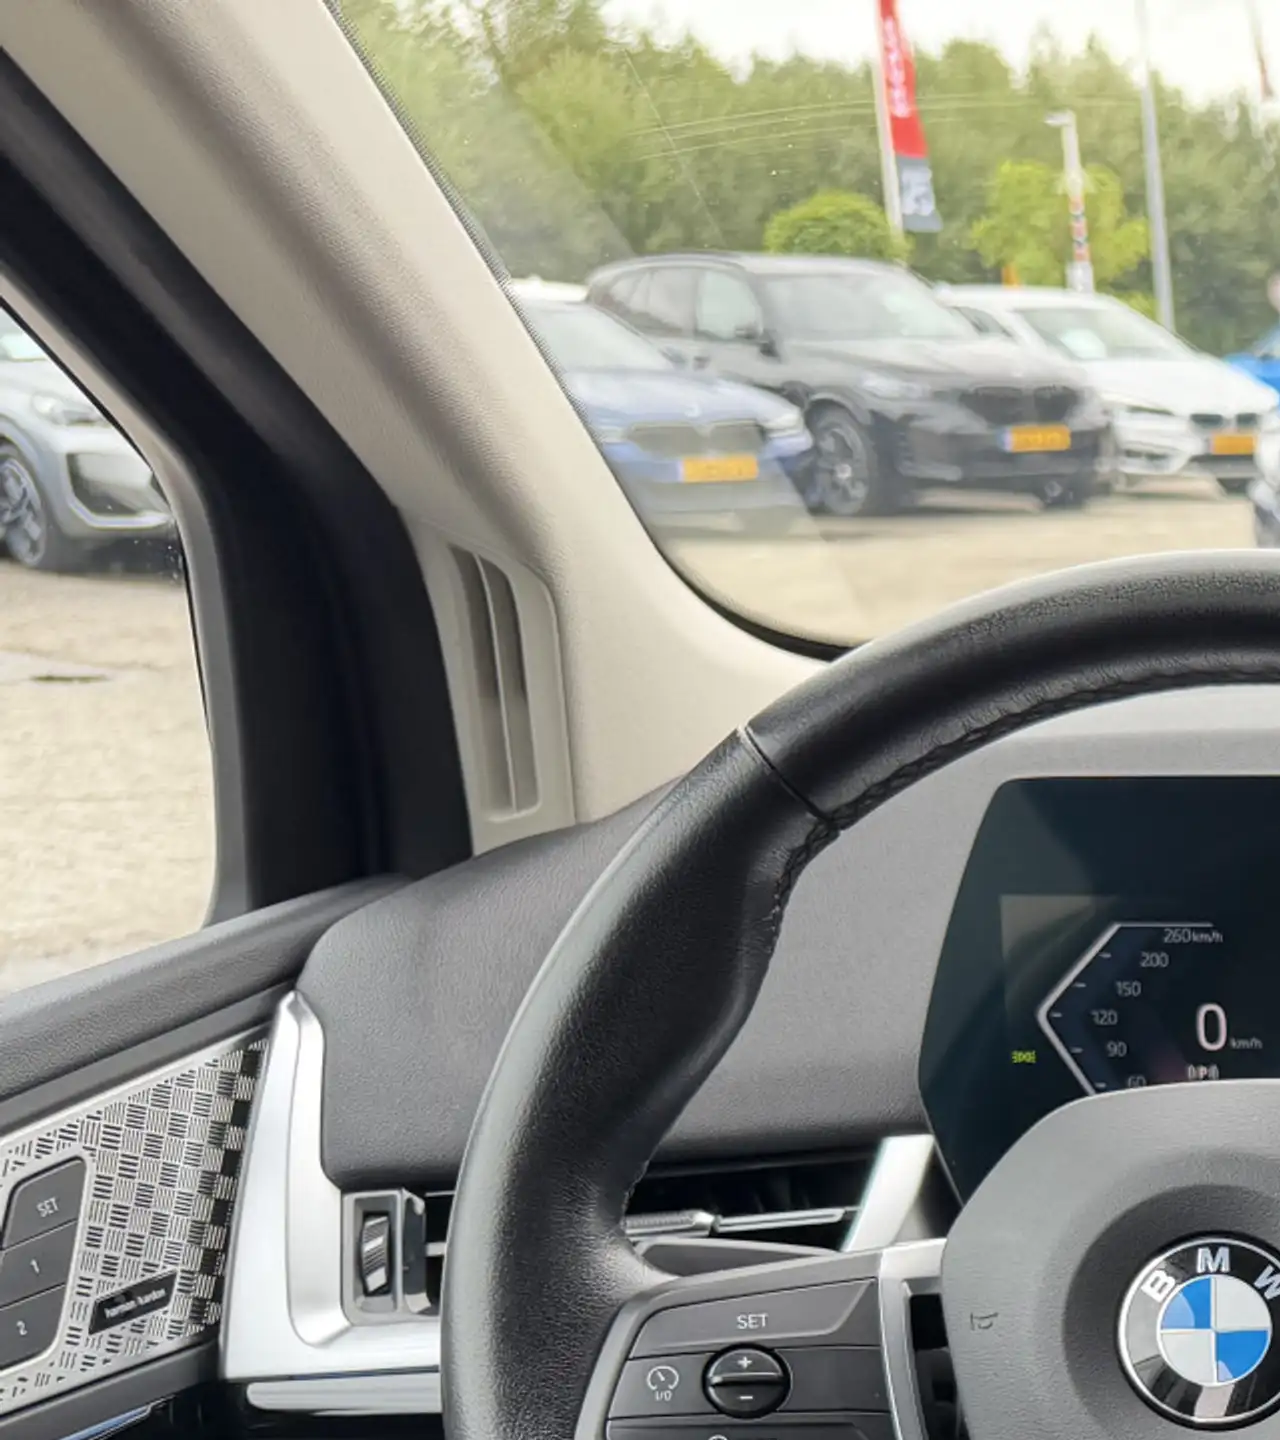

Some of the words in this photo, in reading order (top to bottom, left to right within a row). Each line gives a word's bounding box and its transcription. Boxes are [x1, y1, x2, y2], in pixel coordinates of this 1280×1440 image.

[1139, 951, 1169, 968] 200
[1115, 981, 1142, 996] 150
[1091, 1010, 1118, 1025] 120
[1196, 1003, 1227, 1051] 0
[1107, 1042, 1127, 1057] 90
[37, 1198, 60, 1217] SET
[31, 1259, 40, 1274] 1
[16, 1321, 28, 1336] 2
[736, 1313, 768, 1329] SET
